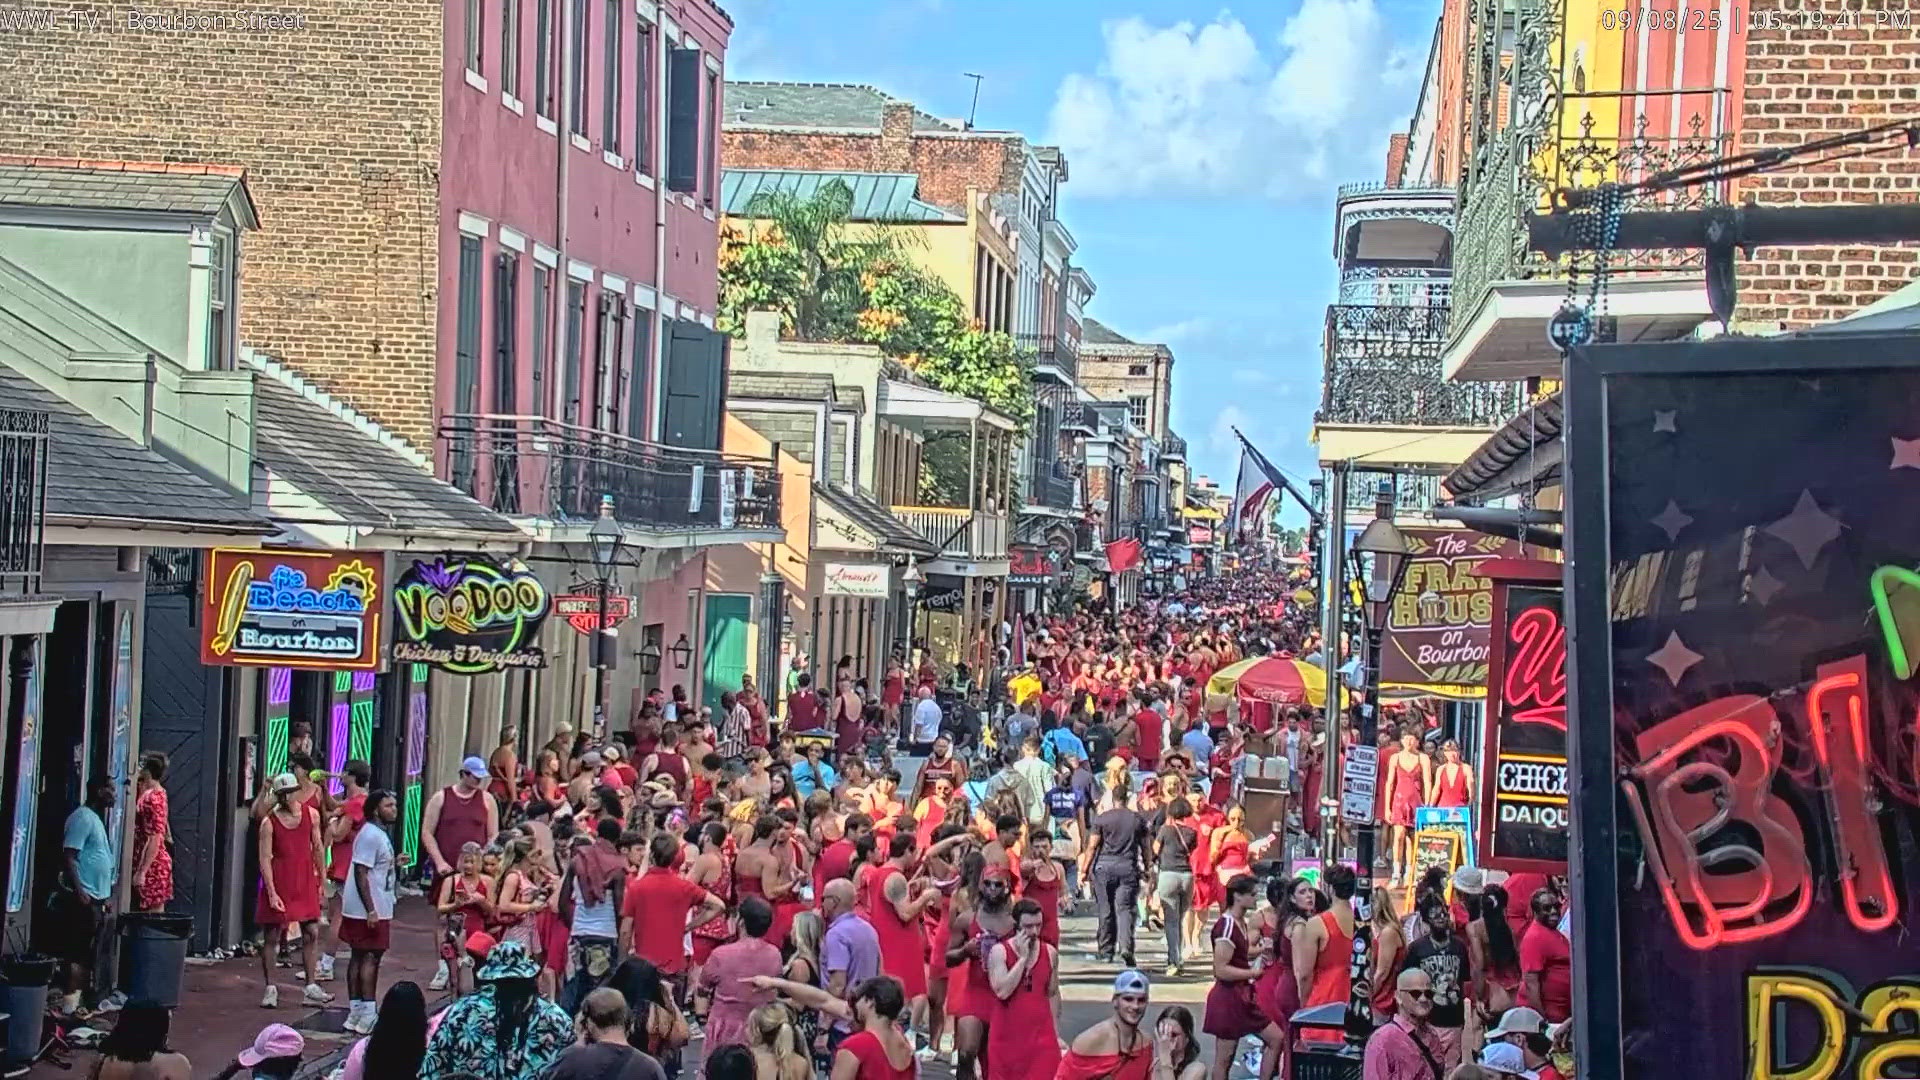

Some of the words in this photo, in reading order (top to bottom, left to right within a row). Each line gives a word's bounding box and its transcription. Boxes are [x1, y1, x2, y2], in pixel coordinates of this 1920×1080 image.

[1434, 533, 1467, 555] The
[249, 585, 364, 612] Beach
[394, 576, 547, 640] VOODOO
[291, 618, 307, 628] on
[240, 629, 355, 651] Bourbon
[1441, 631, 1463, 646] on
[393, 640, 452, 662] Chicken
[467, 644, 543, 669] Daiquiris
[1501, 804, 1569, 829] DAIQU
